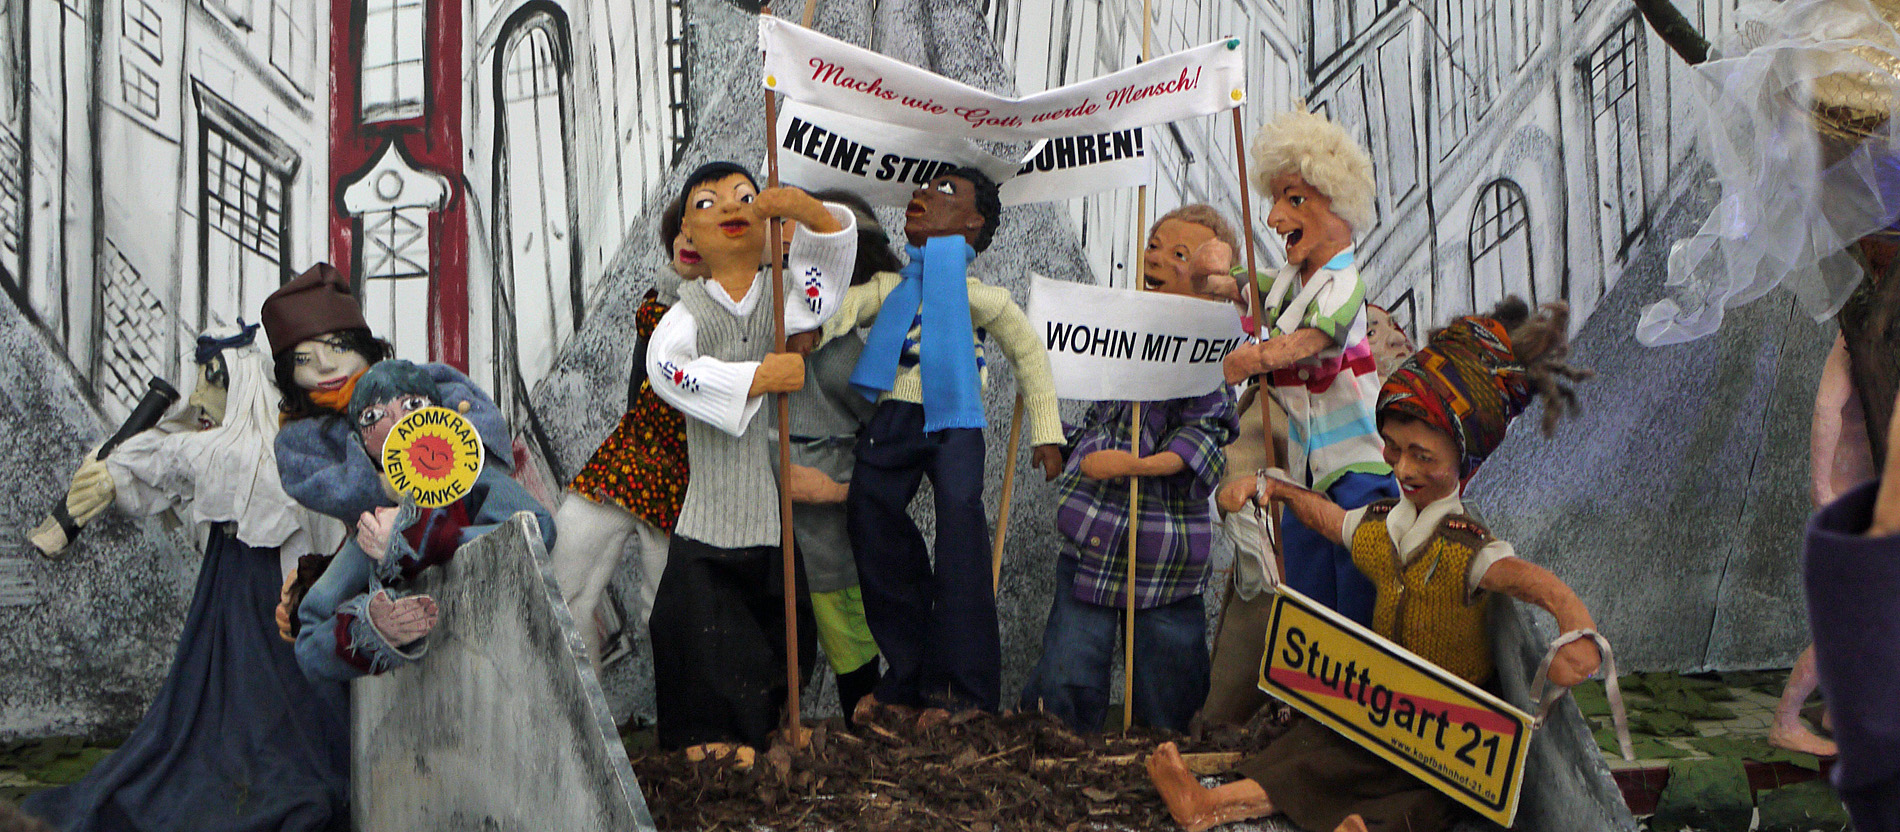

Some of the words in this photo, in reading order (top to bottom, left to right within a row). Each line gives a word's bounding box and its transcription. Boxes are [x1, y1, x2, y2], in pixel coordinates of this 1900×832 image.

[809, 57, 899, 100] Machs
[901, 94, 948, 115] wie
[954, 106, 1023, 128] Gott,
[1031, 98, 1101, 124] werde
[1105, 65, 1202, 110] Mensch!
[782, 116, 876, 178] KEINE
[1046, 321, 1137, 360] WOHIN
[1141, 334, 1189, 364] MIT
[1188, 336, 1241, 364] DEM
[387, 448, 411, 491] NEIN
[412, 479, 466, 505] DANKE
[1282, 626, 1449, 751] Stuttgart
[1454, 721, 1501, 777] 21
[1390, 736, 1497, 801] www.kopfbahnhof-21.de
